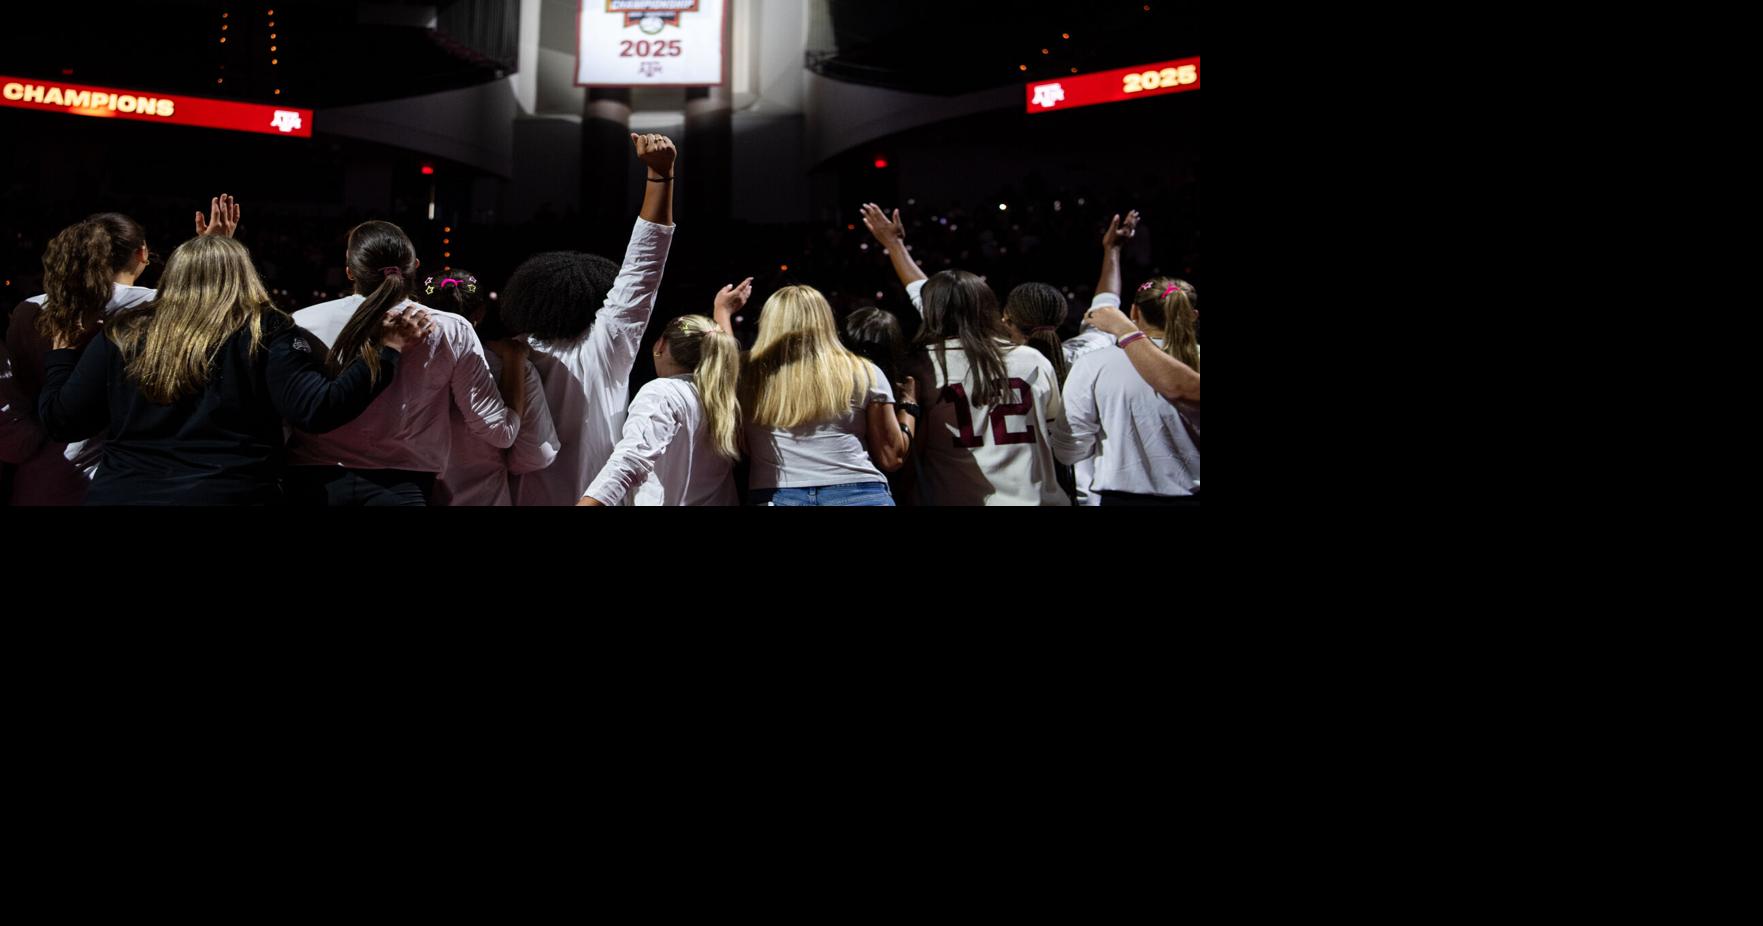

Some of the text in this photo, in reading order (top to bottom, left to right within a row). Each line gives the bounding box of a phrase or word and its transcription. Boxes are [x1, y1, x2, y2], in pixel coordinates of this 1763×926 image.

[619, 40, 682, 57] 2025
[1123, 64, 1198, 94] 2025
[3, 82, 175, 117] CHAMPIONS
[937, 377, 1036, 449] 12
